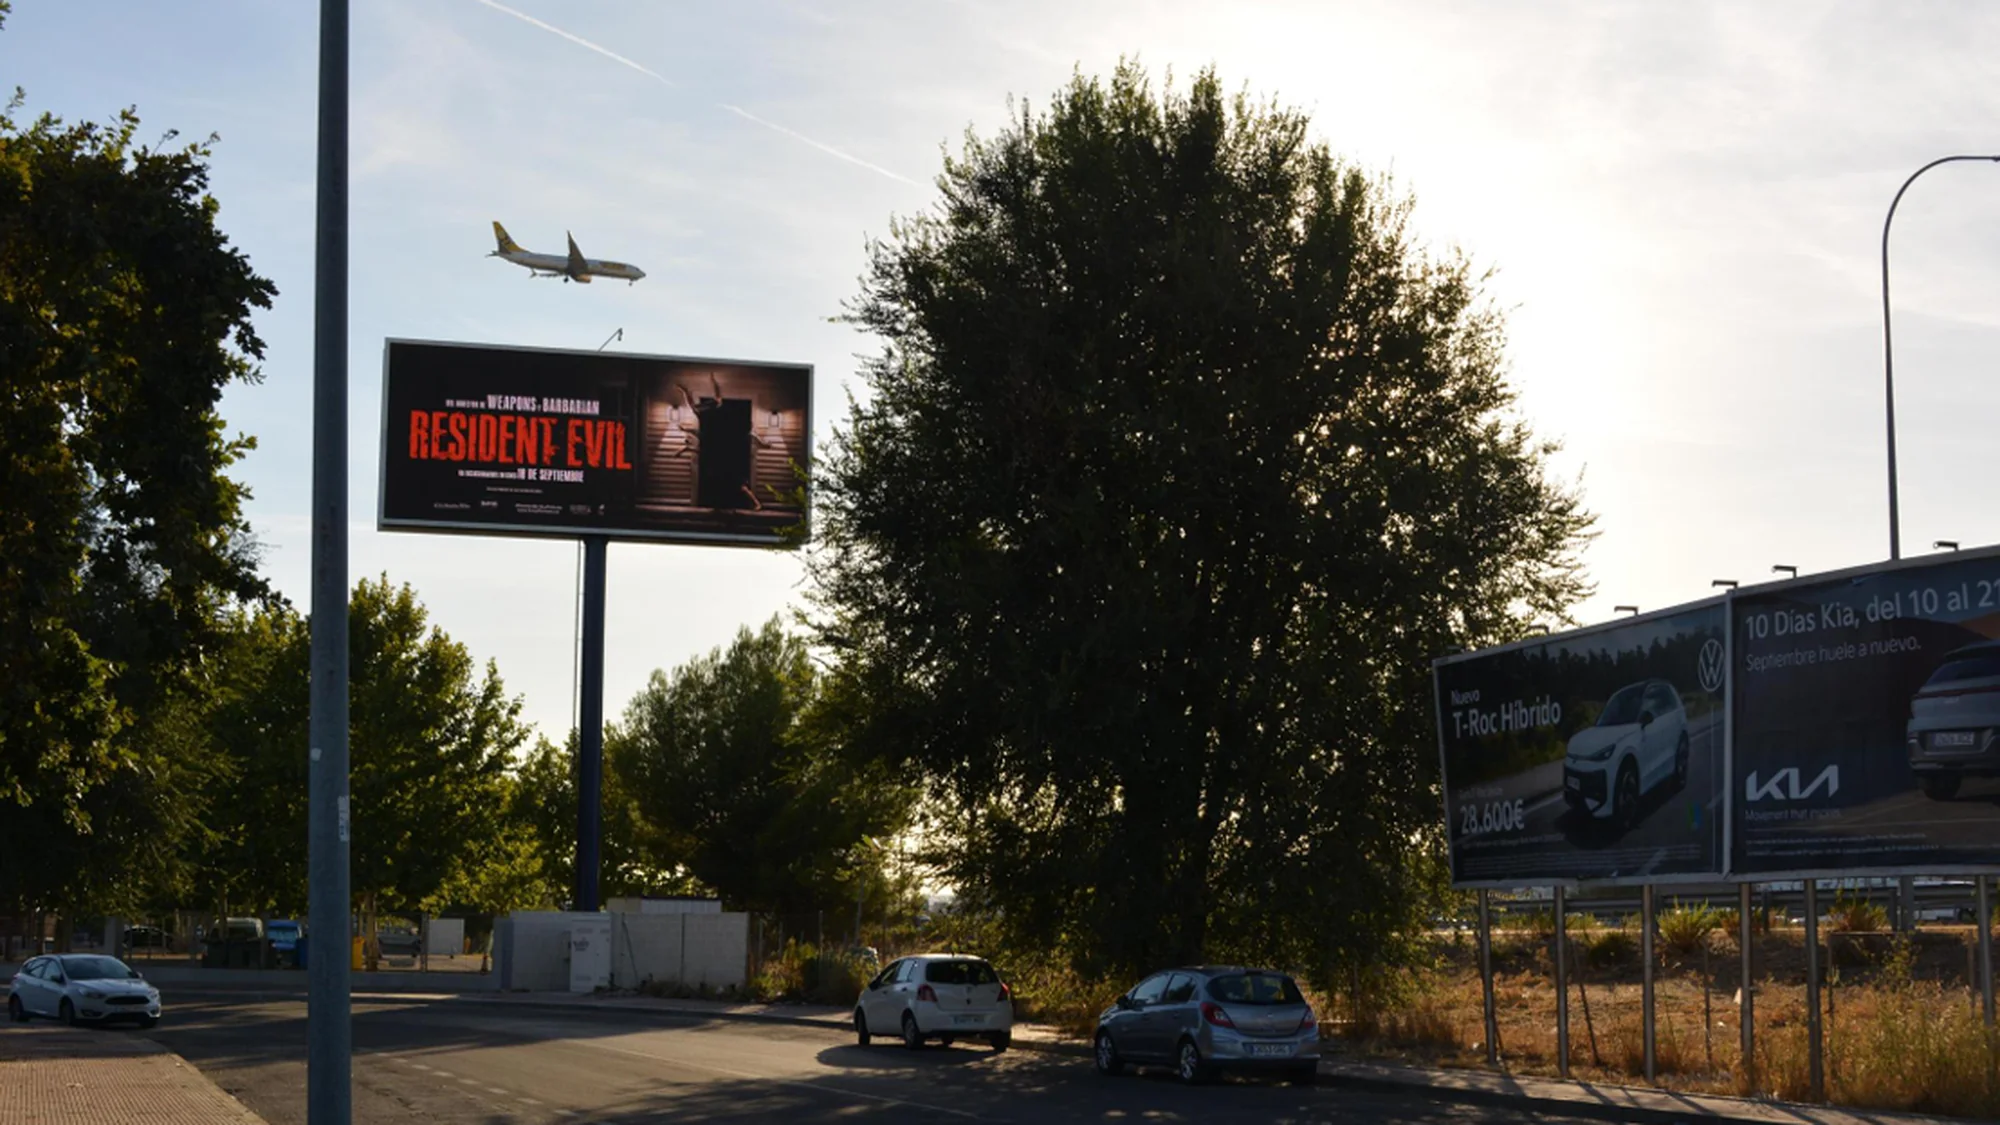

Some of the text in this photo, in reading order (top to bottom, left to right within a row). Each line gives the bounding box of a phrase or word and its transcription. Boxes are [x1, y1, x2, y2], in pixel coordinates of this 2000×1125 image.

[486, 394, 537, 412] WEAPONS
[542, 398, 600, 415] BARBARIAN
[409, 410, 632, 469] RESIDENT EVIL
[528, 468, 537, 481] DE
[539, 469, 584, 483] SEPTIEMBRE
[1745, 614, 1769, 640] 10
[1774, 608, 1816, 637] Días
[1821, 602, 1860, 630] Kia,
[1866, 592, 1902, 625] del
[1909, 587, 1938, 616] 10
[1947, 581, 1969, 612] al
[1745, 634, 1922, 673] Septiembre huele a nuevo.
[1450, 688, 1480, 706] Nuevo
[1452, 693, 1561, 739] T-Roc Híbrido
[1745, 763, 1840, 802] KIA
[1459, 797, 1525, 835] 28.600€
